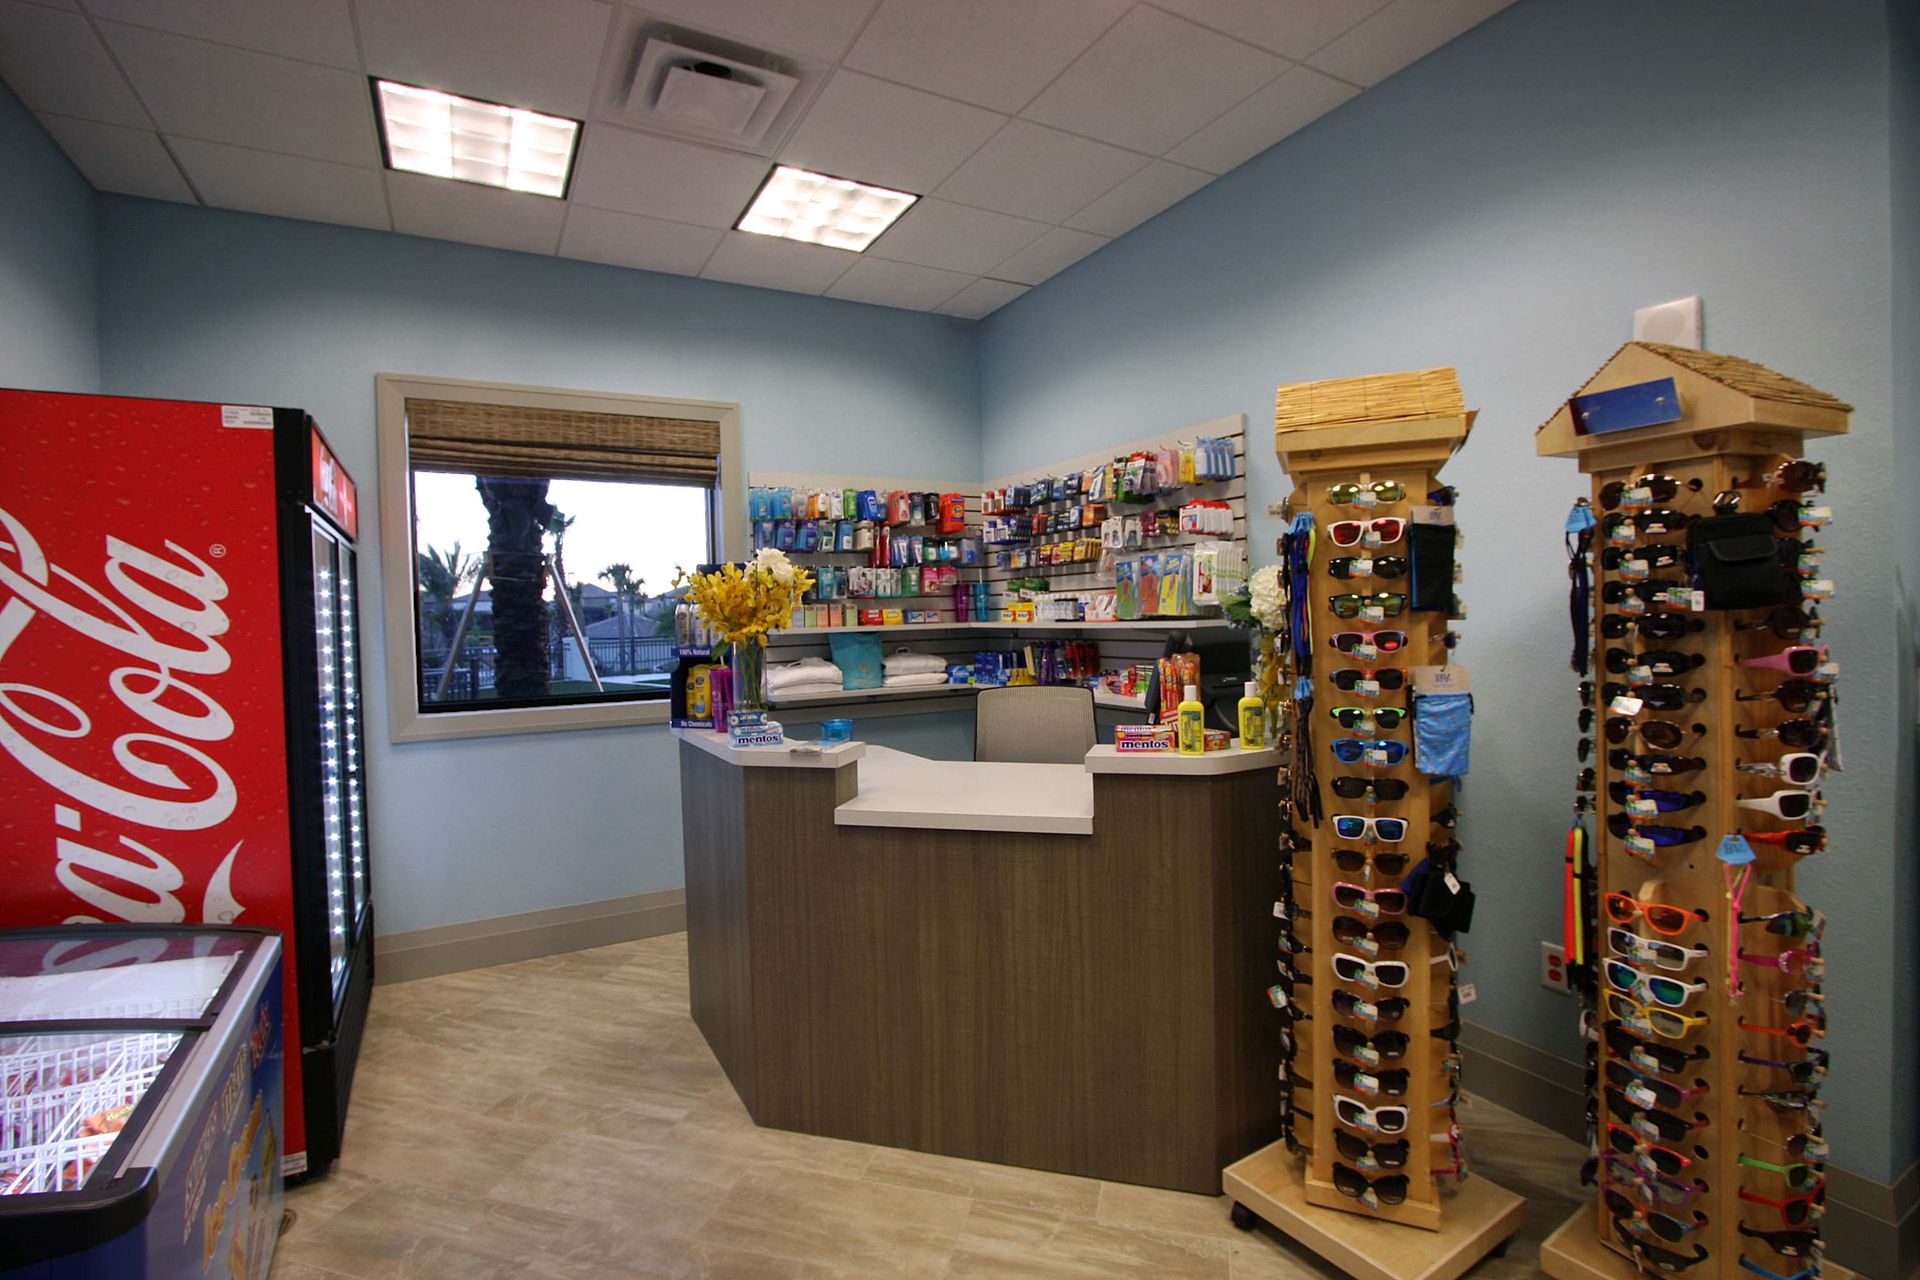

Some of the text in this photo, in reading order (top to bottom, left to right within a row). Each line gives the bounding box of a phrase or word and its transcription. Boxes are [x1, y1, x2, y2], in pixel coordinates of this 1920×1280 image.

[693, 648, 710, 656] Natural
[688, 720, 712, 728] Chemicals
[737, 734, 779, 744] mentos
[1120, 740, 1170, 749] mentos
